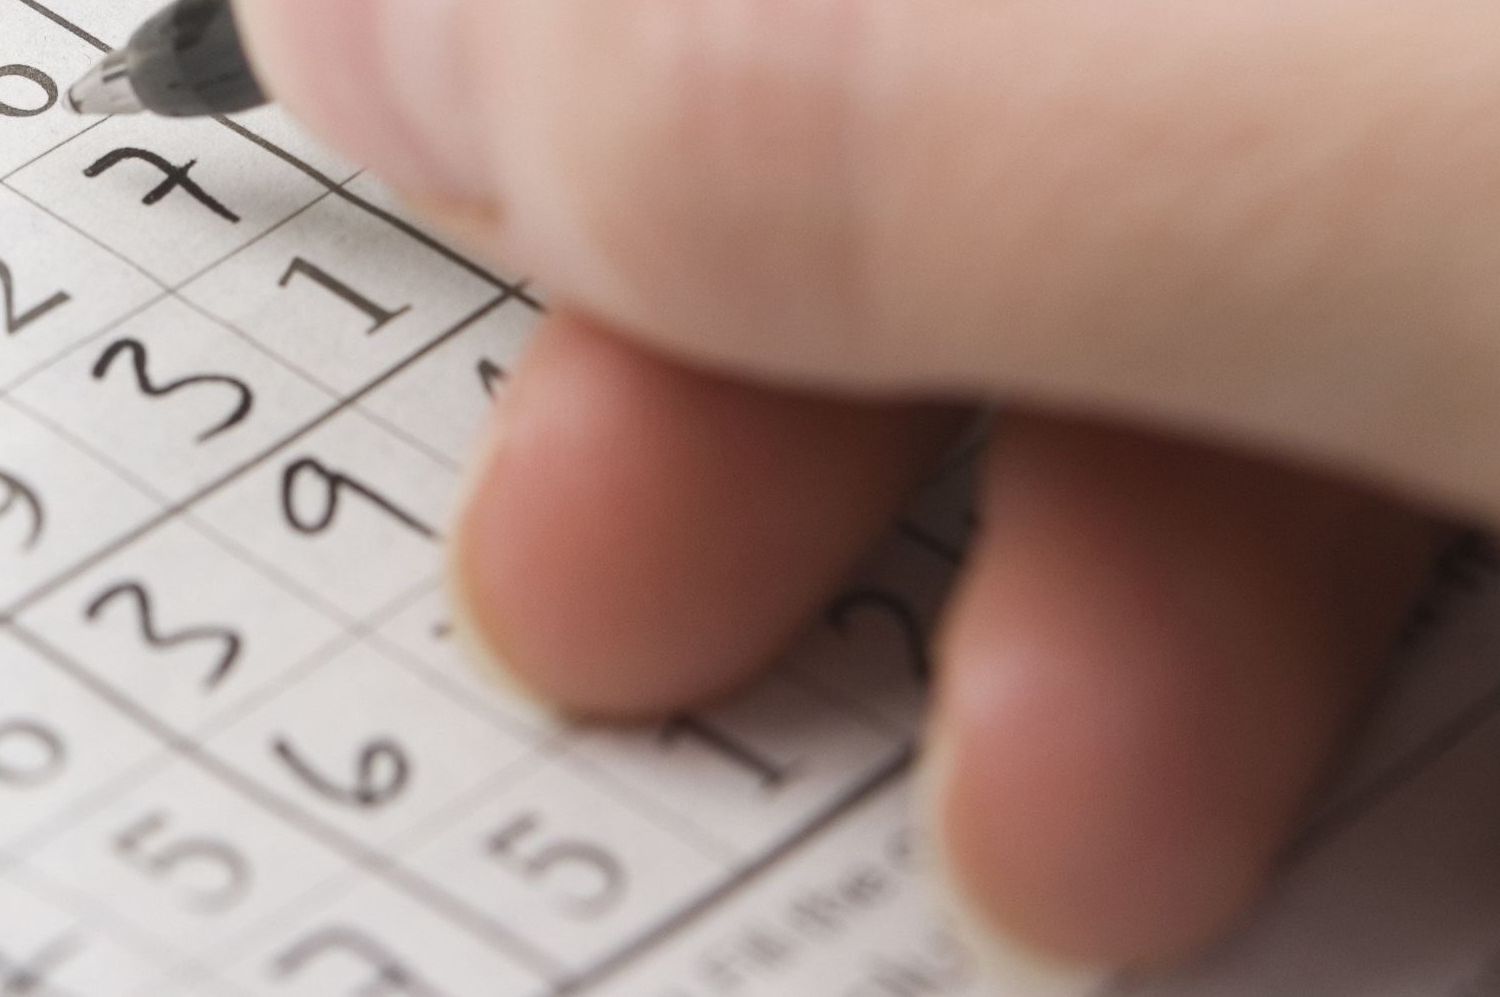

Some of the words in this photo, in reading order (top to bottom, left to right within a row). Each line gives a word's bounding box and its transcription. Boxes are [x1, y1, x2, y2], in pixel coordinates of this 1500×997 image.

[83, 146, 240, 223] 7
[278, 255, 412, 335] 1
[92, 339, 253, 444] 3
[281, 457, 442, 537] 9
[85, 582, 242, 692] 3
[269, 732, 413, 807] 6
[109, 810, 255, 917] 5
[488, 813, 630, 923] 5
